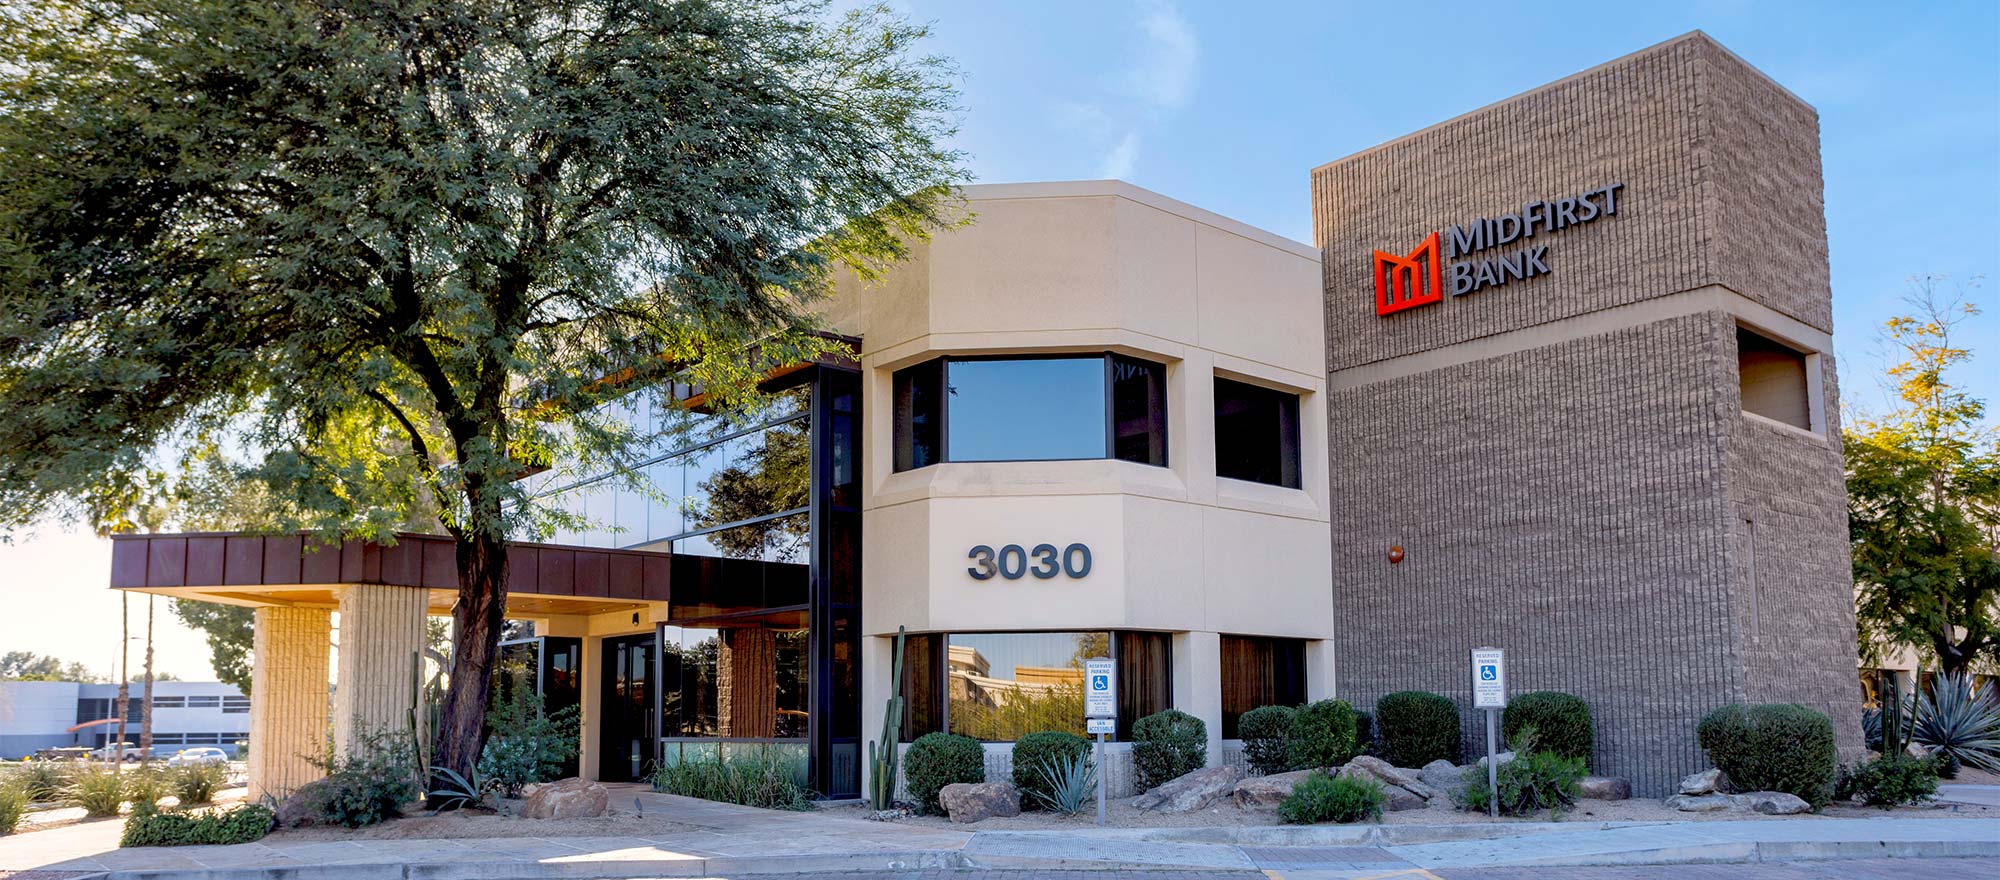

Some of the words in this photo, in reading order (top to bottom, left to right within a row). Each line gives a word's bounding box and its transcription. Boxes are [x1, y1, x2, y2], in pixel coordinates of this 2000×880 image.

[1449, 182, 1624, 258] MIDFIRST
[1450, 246, 1551, 297] BANK
[967, 543, 1092, 580] 3030
